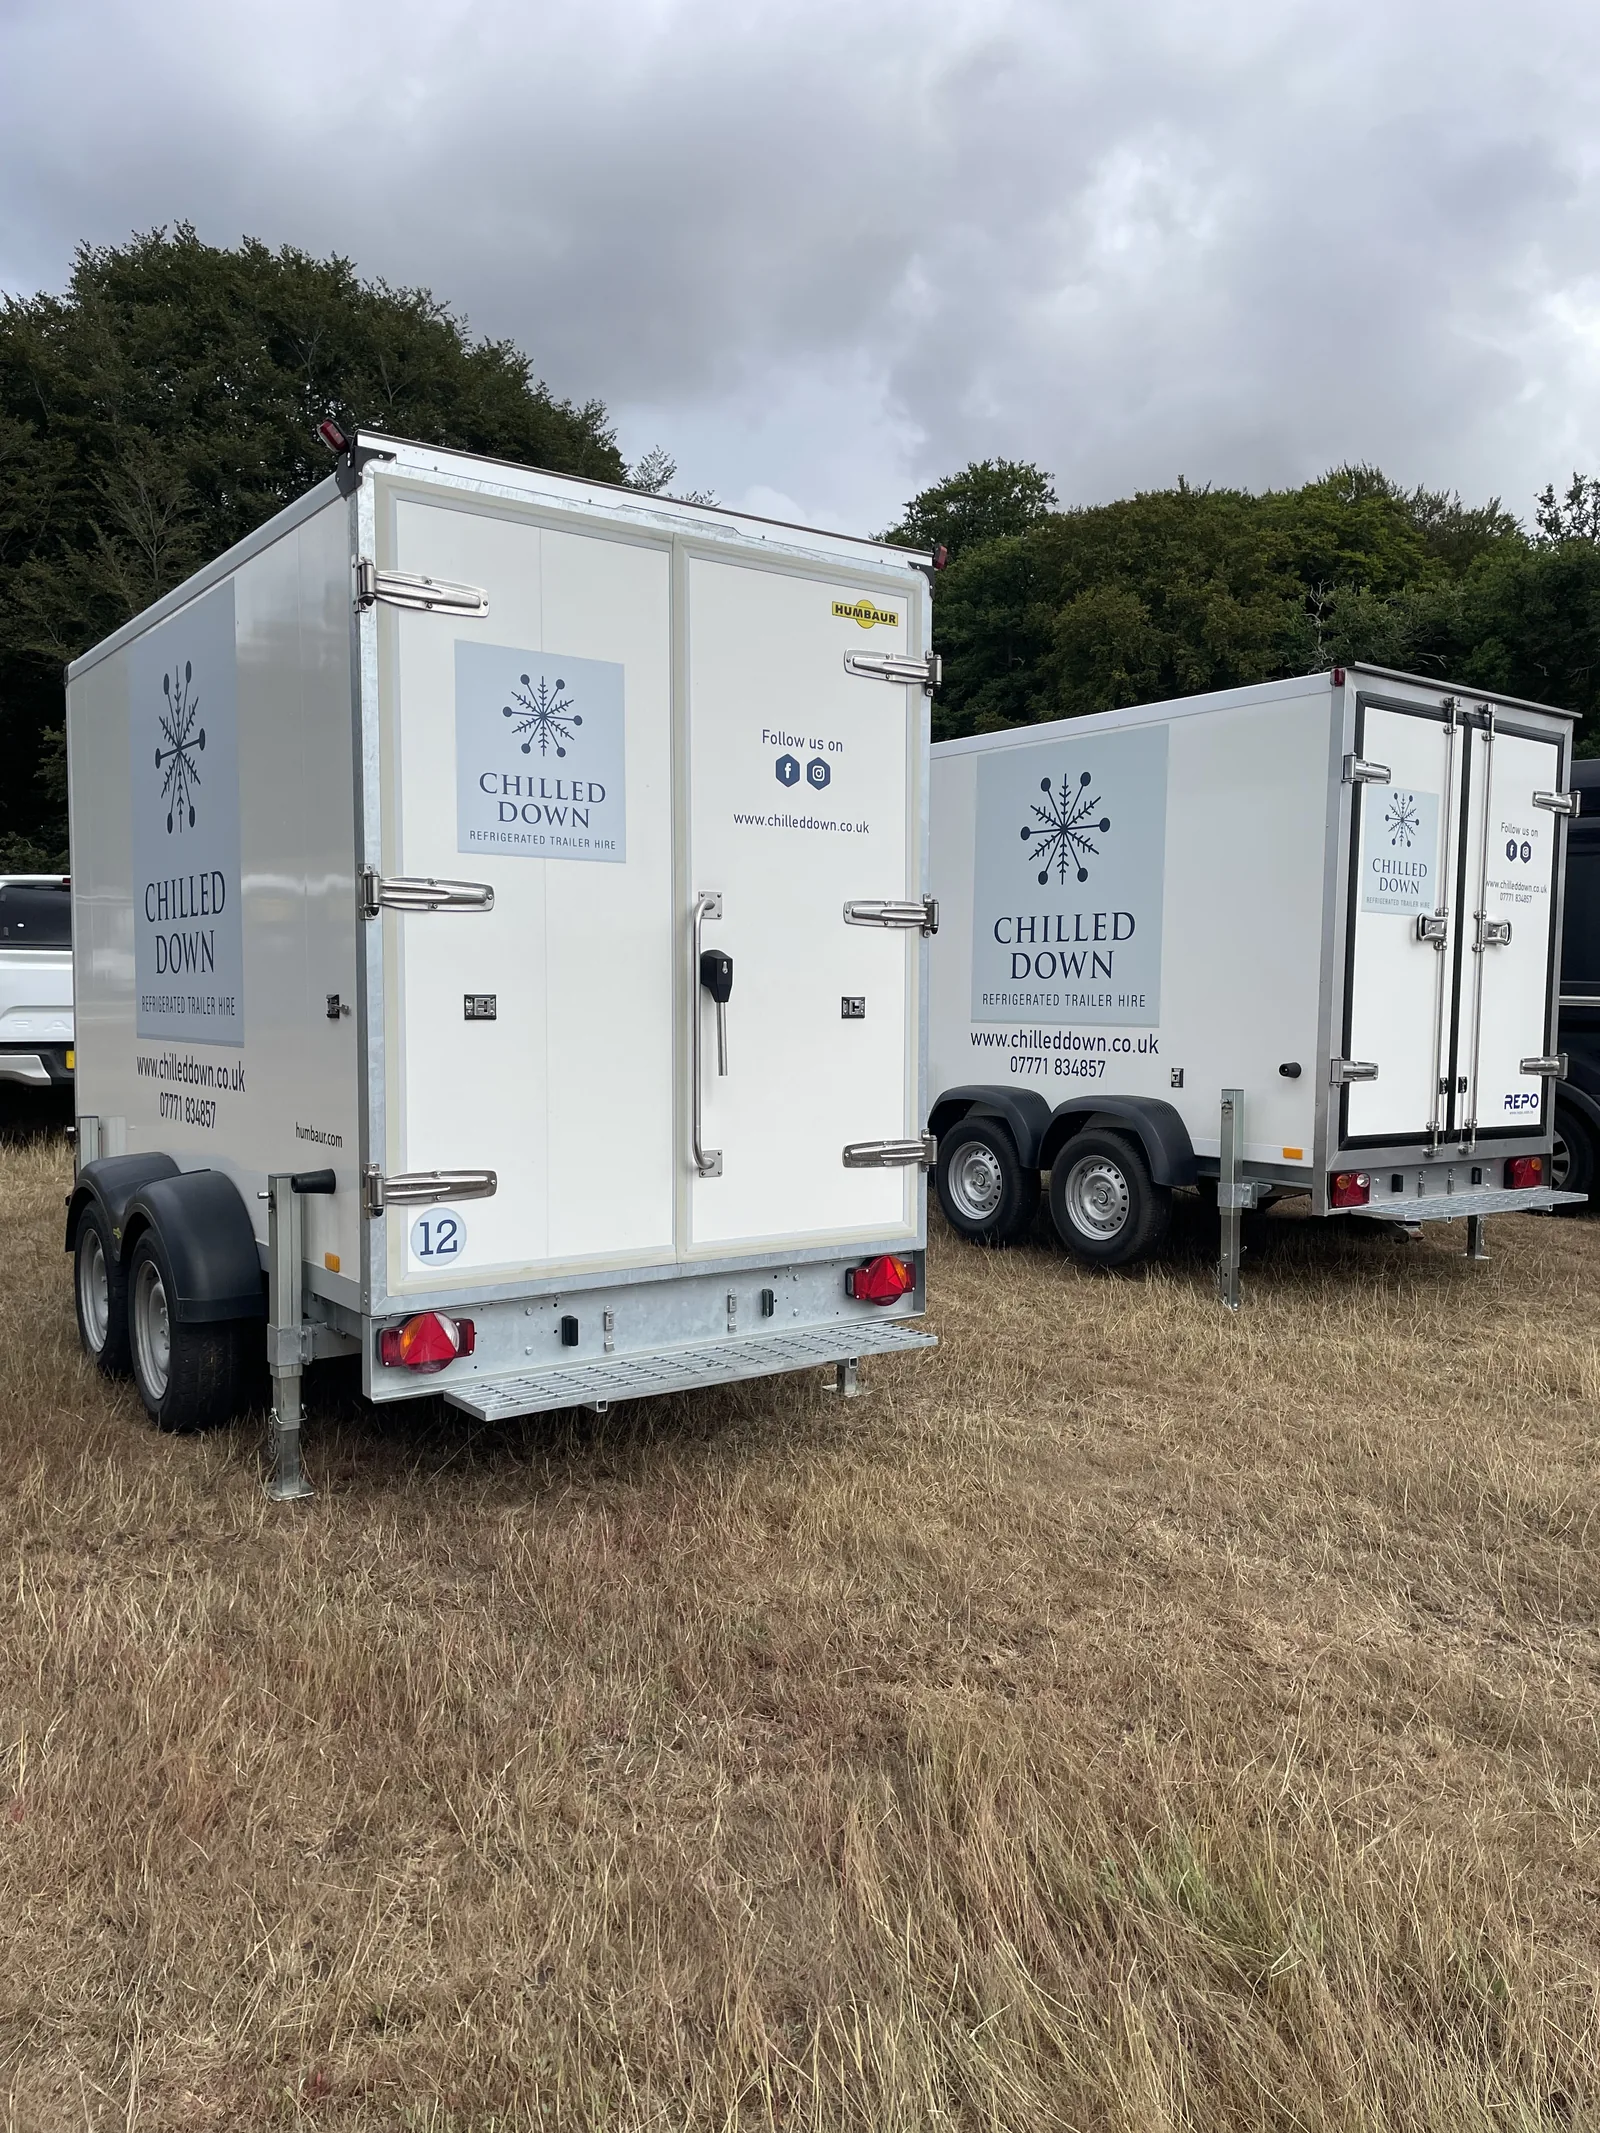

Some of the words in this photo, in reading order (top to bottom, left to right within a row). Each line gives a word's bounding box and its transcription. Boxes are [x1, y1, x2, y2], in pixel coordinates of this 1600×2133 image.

[834, 604, 897, 624] HUMBAUR
[762, 729, 805, 748] Follow
[809, 737, 824, 750] us
[828, 740, 843, 752] on
[479, 772, 606, 803] CHILLED
[497, 800, 591, 829] DOWN
[733, 813, 870, 834] www.chilleddown.co.uk
[469, 830, 546, 845] REFRIGERATED
[550, 836, 590, 848] TRAILER
[594, 839, 616, 850] HIRE
[1501, 821, 1521, 835] Follow
[1522, 828, 1530, 836] us
[1531, 829, 1539, 838] on
[1372, 858, 1428, 878] CHILLED
[145, 870, 226, 923] CHILLED
[1379, 877, 1420, 894] DOWN
[1500, 892, 1514, 902] 07771
[1366, 896, 1400, 906] REFRIGERATED
[1400, 898, 1419, 908] TRAILER
[993, 911, 1136, 945] CHILLED
[155, 929, 215, 974] DOWN
[1010, 950, 1115, 980] DOWN
[141, 995, 186, 1014] REFRIGERATED
[187, 996, 216, 1015] TRAILER
[218, 997, 236, 1016] HIRE
[982, 993, 1060, 1007] REFRIGERATED
[1065, 994, 1113, 1008] TRAILER
[1118, 994, 1146, 1008] HIRE
[970, 1029, 1160, 1055] www.chilleddown.co.uk
[136, 1052, 246, 1093] www.chilleddown.co.uk
[1010, 1055, 1048, 1075] 07771
[1054, 1058, 1106, 1078] 834857
[159, 1091, 183, 1122] 07771
[185, 1096, 216, 1129] 834857
[1504, 1093, 1539, 1110] REPO
[295, 1121, 343, 1149] humbaur.com
[419, 1219, 458, 1256] 12
